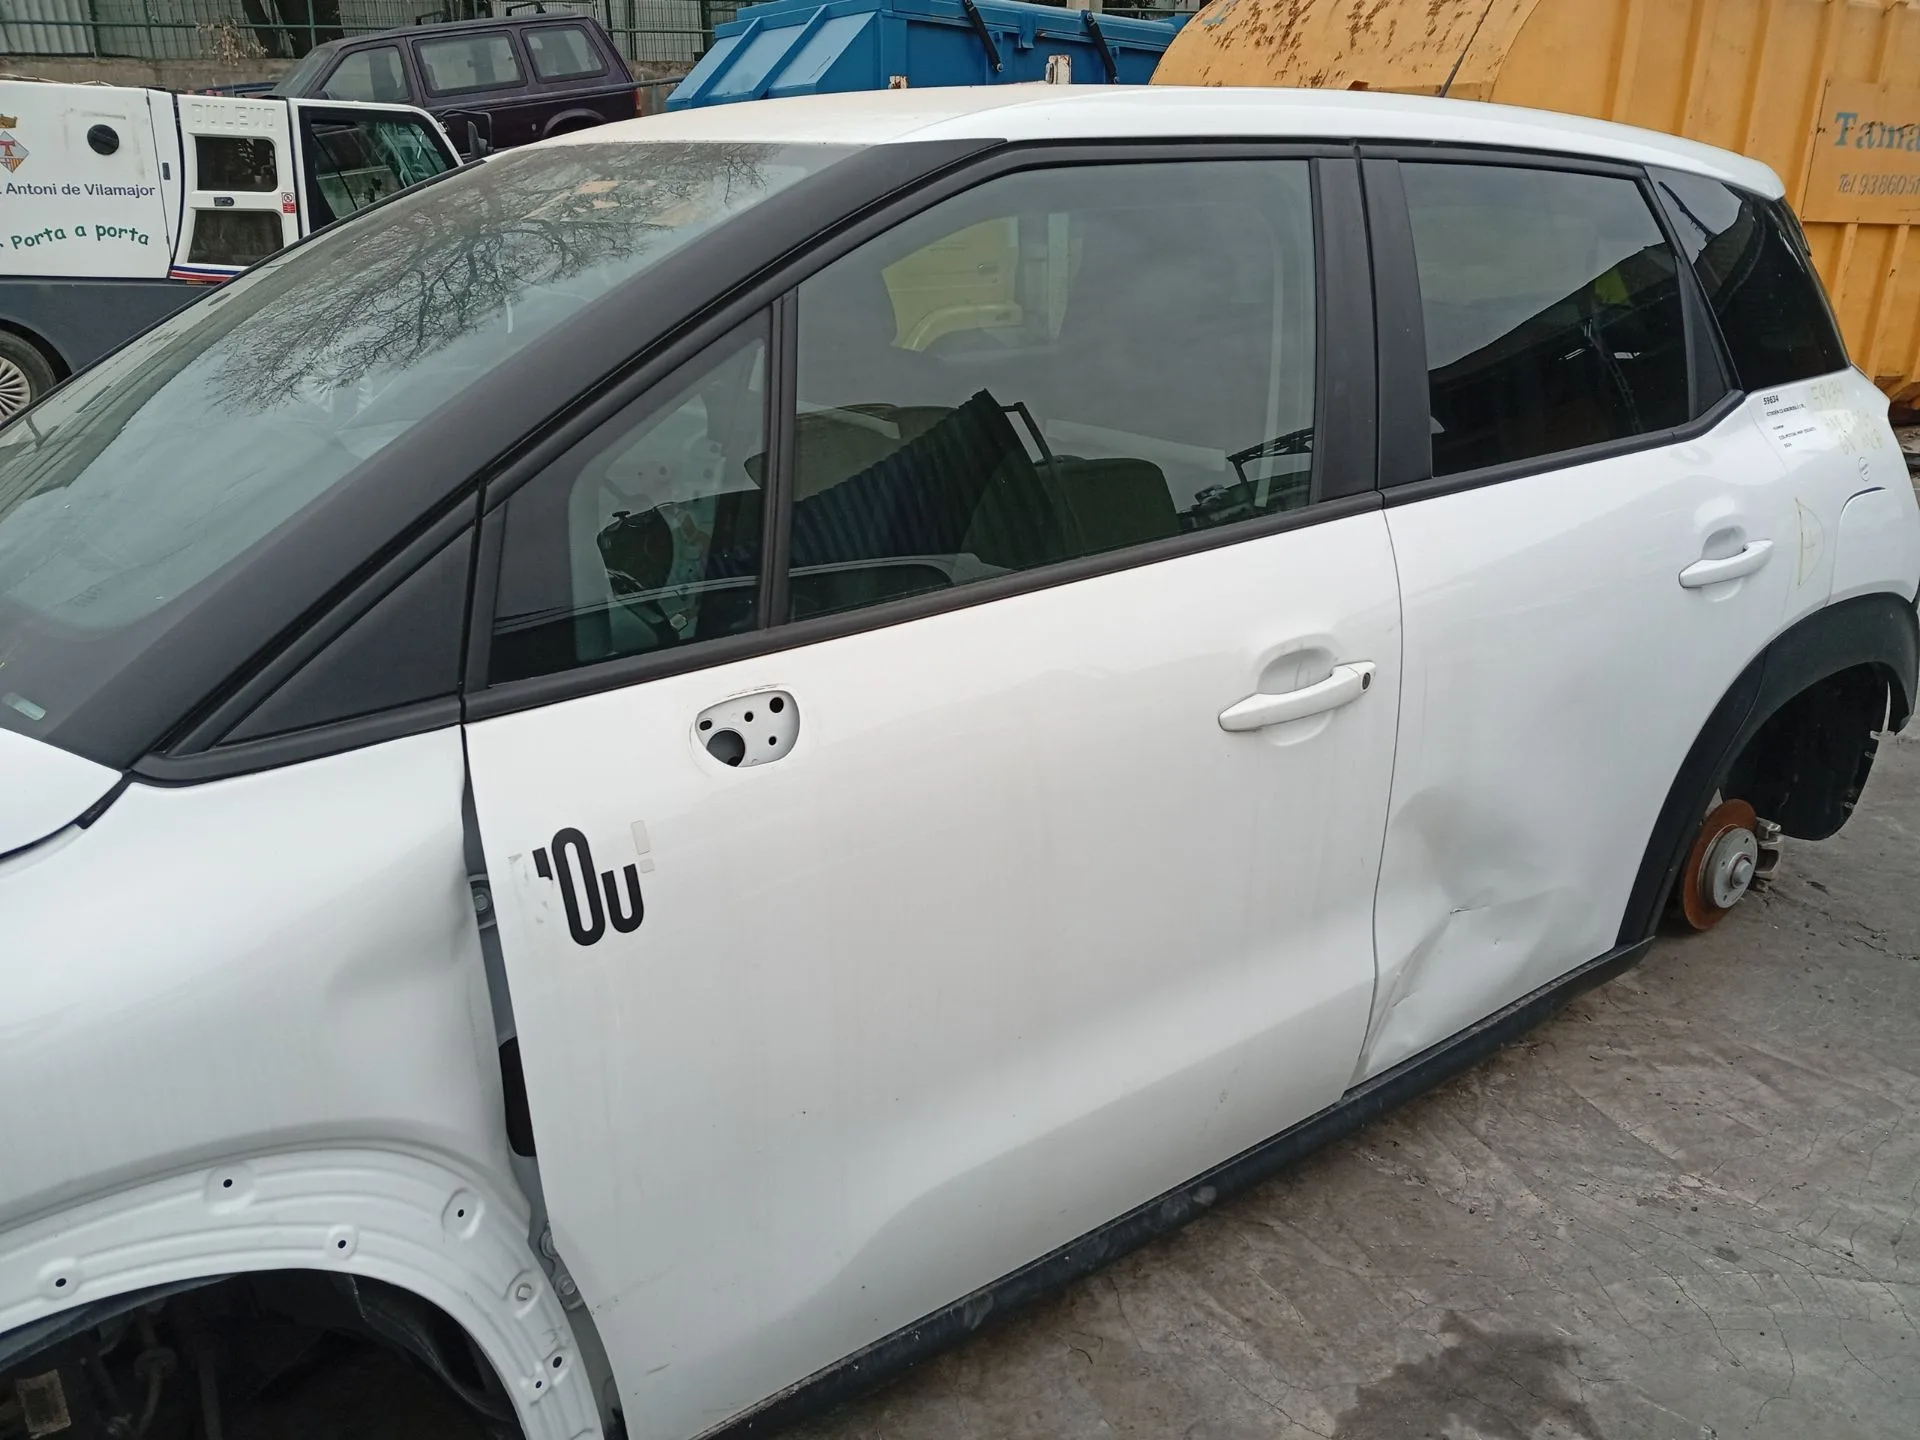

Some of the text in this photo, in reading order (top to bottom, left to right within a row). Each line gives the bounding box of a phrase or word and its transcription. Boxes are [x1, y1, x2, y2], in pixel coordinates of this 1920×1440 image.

[5, 182, 58, 195] Antoni
[61, 183, 81, 195] de
[84, 184, 156, 198] Vilamajor
[10, 224, 149, 249] Porta a porta
[1763, 394, 1780, 406] 59634
